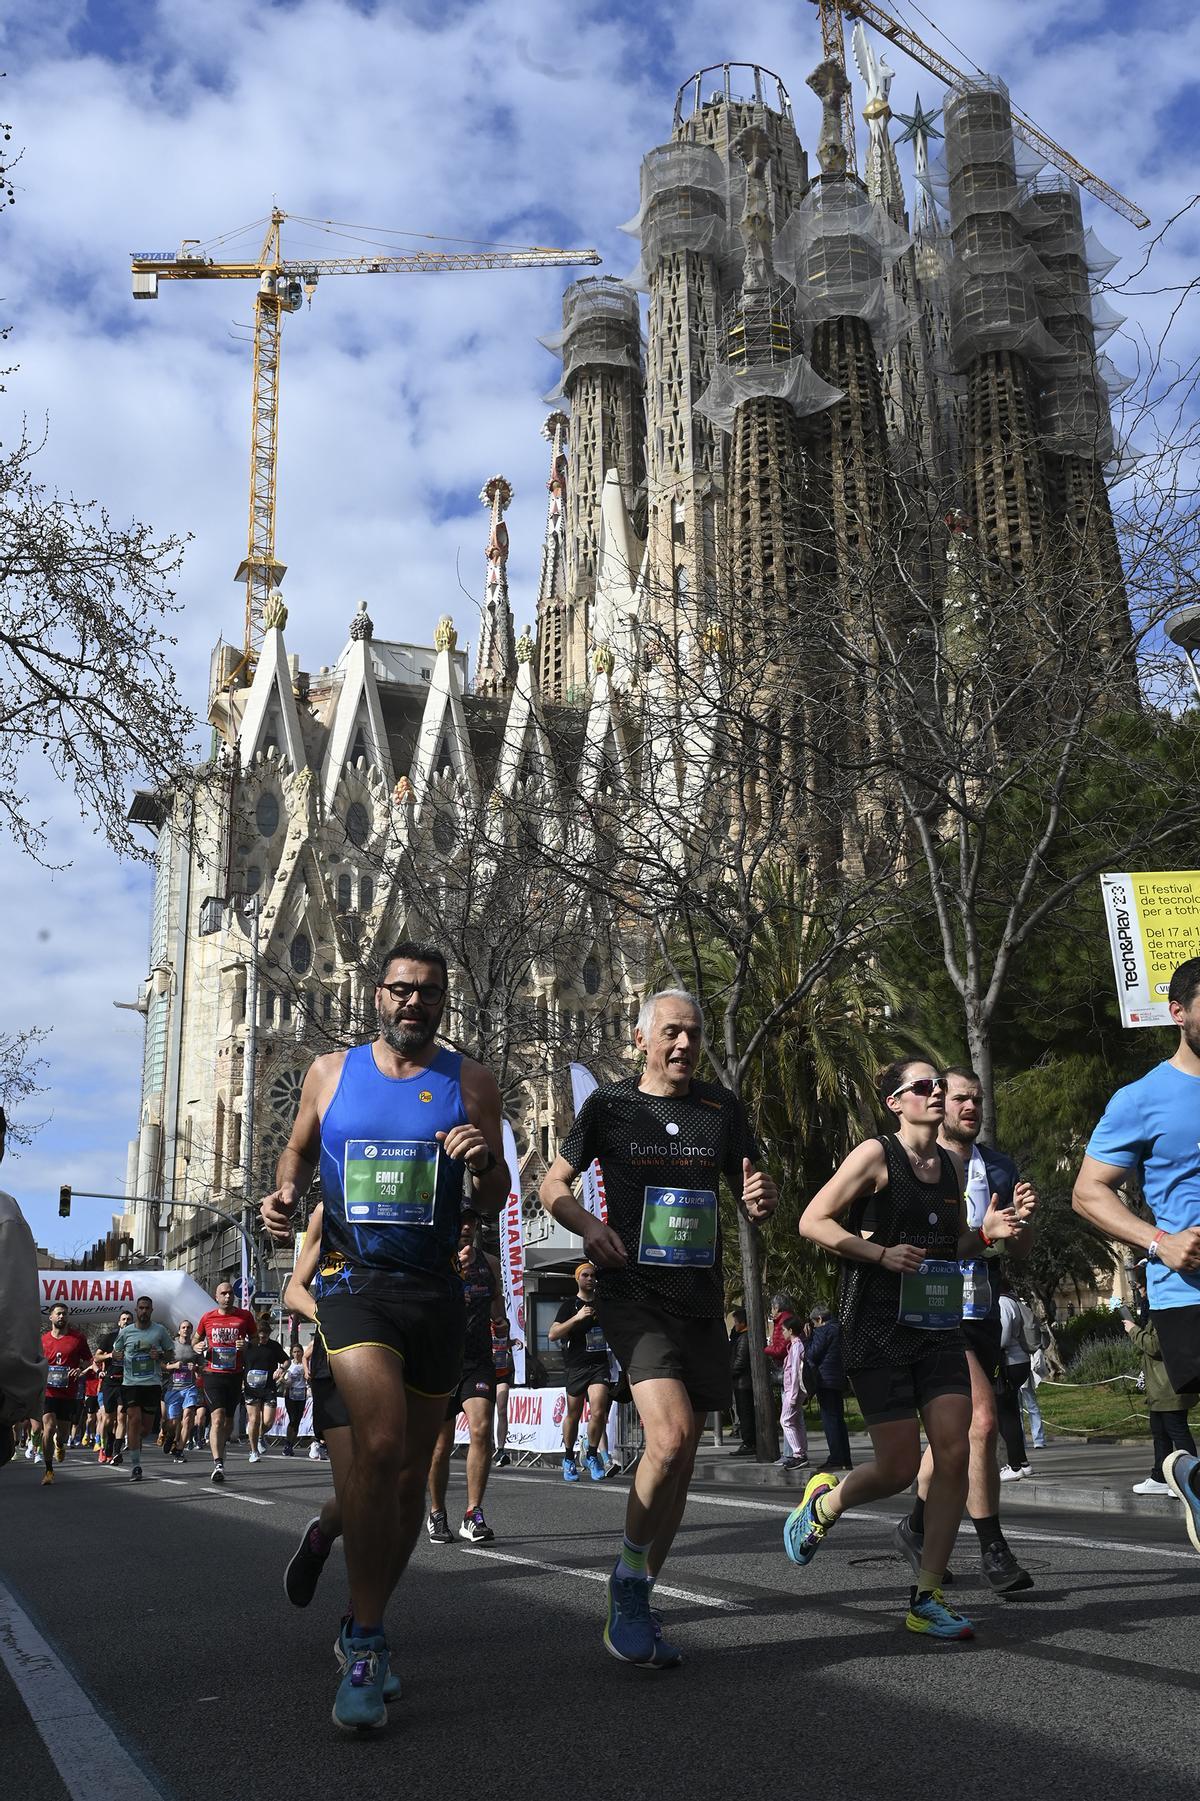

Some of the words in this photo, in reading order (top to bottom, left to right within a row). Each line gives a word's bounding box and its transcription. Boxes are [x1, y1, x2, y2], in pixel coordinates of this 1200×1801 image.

[134, 252, 175, 260] POTAIN
[1138, 885, 1149, 895] El
[1152, 883, 1193, 894] festival
[1140, 896, 1155, 905] de
[1142, 908, 1161, 918] per
[1175, 905, 1200, 915] toth
[1146, 928, 1165, 938] Del
[1168, 927, 1179, 937] 17
[1182, 927, 1193, 937] al
[1116, 908, 1139, 991] Tech&Play
[1148, 939, 1163, 949] de
[1166, 940, 1195, 950] març
[1149, 950, 1187, 960] Teatre
[1151, 961, 1167, 971] de
[381, 1148, 416, 1157] ZURICH
[630, 1142, 668, 1156] Punto
[669, 1141, 715, 1157] Blanco
[376, 1171, 404, 1184] EMILI
[380, 1184, 397, 1195] 249
[678, 1196, 705, 1205] ZURICH
[668, 1216, 699, 1229] RAMON
[42, 1279, 134, 1301] YAMAHA
[925, 1285, 949, 1296] MARIA
